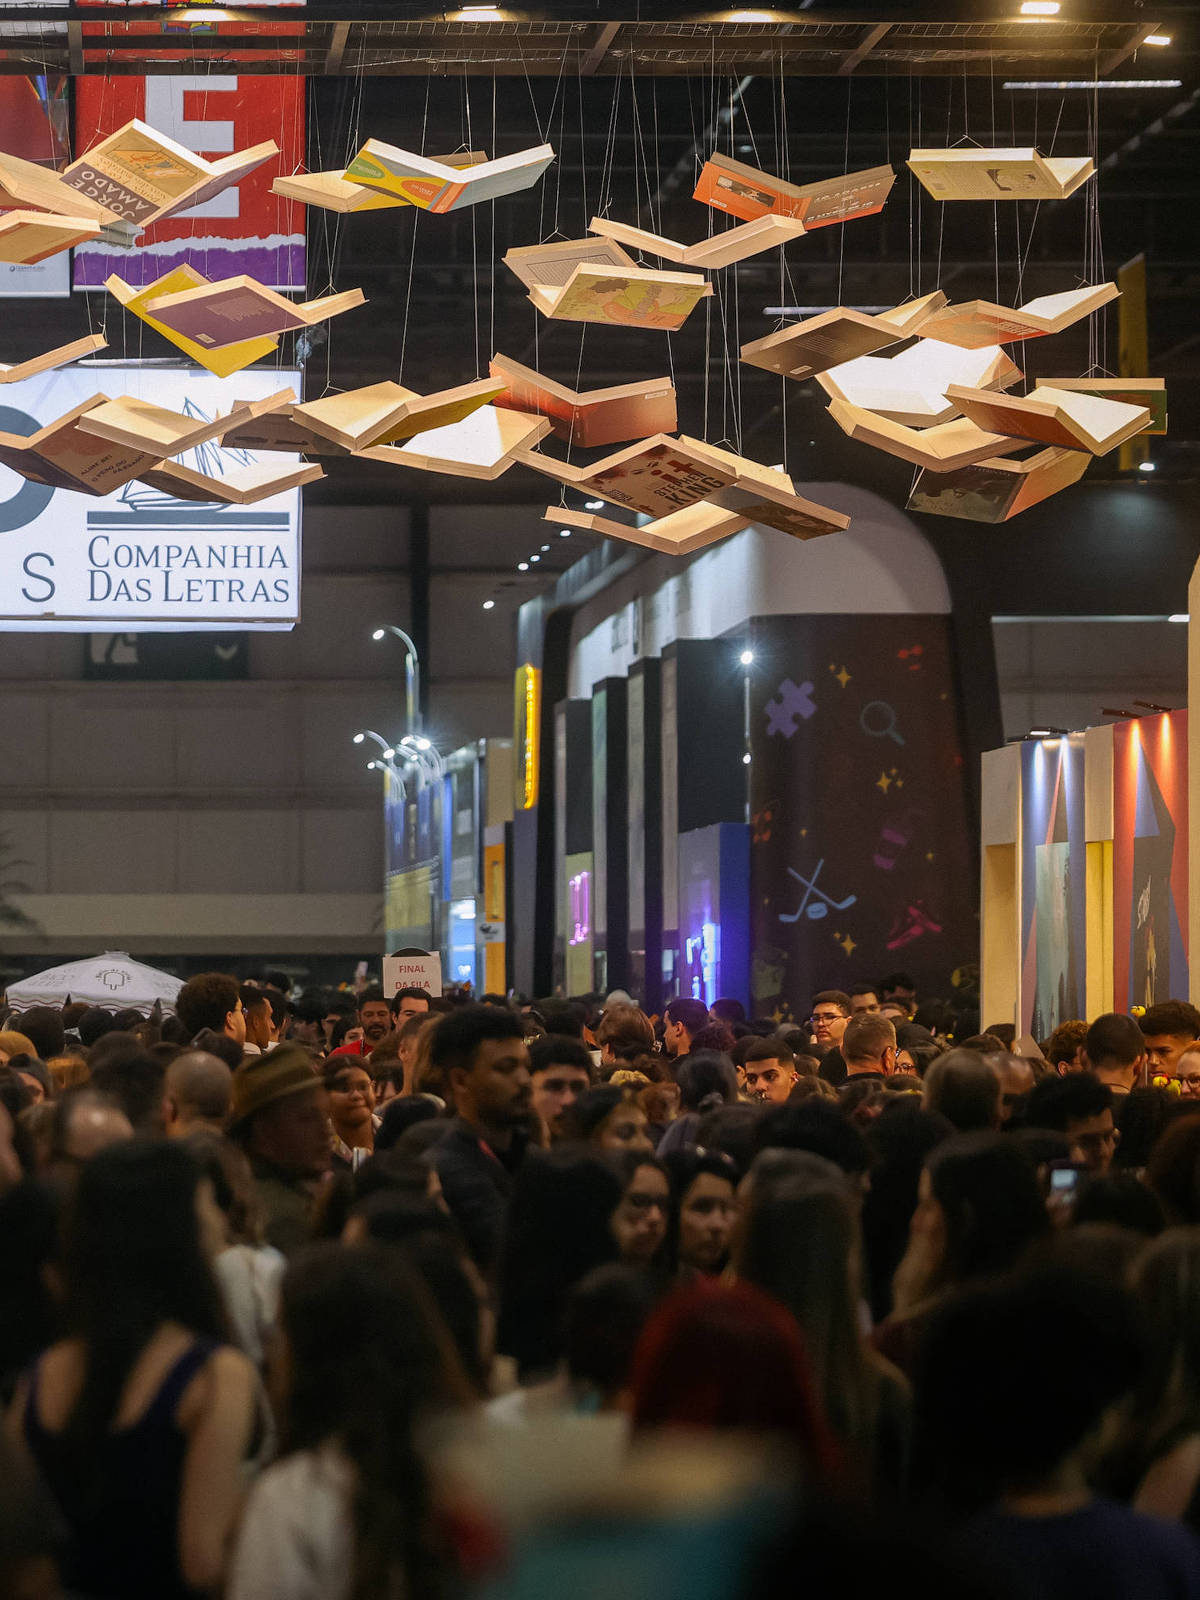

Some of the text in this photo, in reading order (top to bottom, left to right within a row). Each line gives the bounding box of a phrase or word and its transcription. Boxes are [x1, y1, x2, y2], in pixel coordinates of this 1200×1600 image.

[145, 75, 240, 218] E
[69, 178, 137, 219] JORGE
[81, 170, 150, 211] AMADO
[654, 470, 708, 497] STEPHEN
[664, 476, 726, 506] KING
[87, 535, 290, 569] COMPANHIA
[162, 569, 291, 603] LETRAS
[395, 980, 431, 990] DA FILA
[399, 965, 426, 974] FINAL
